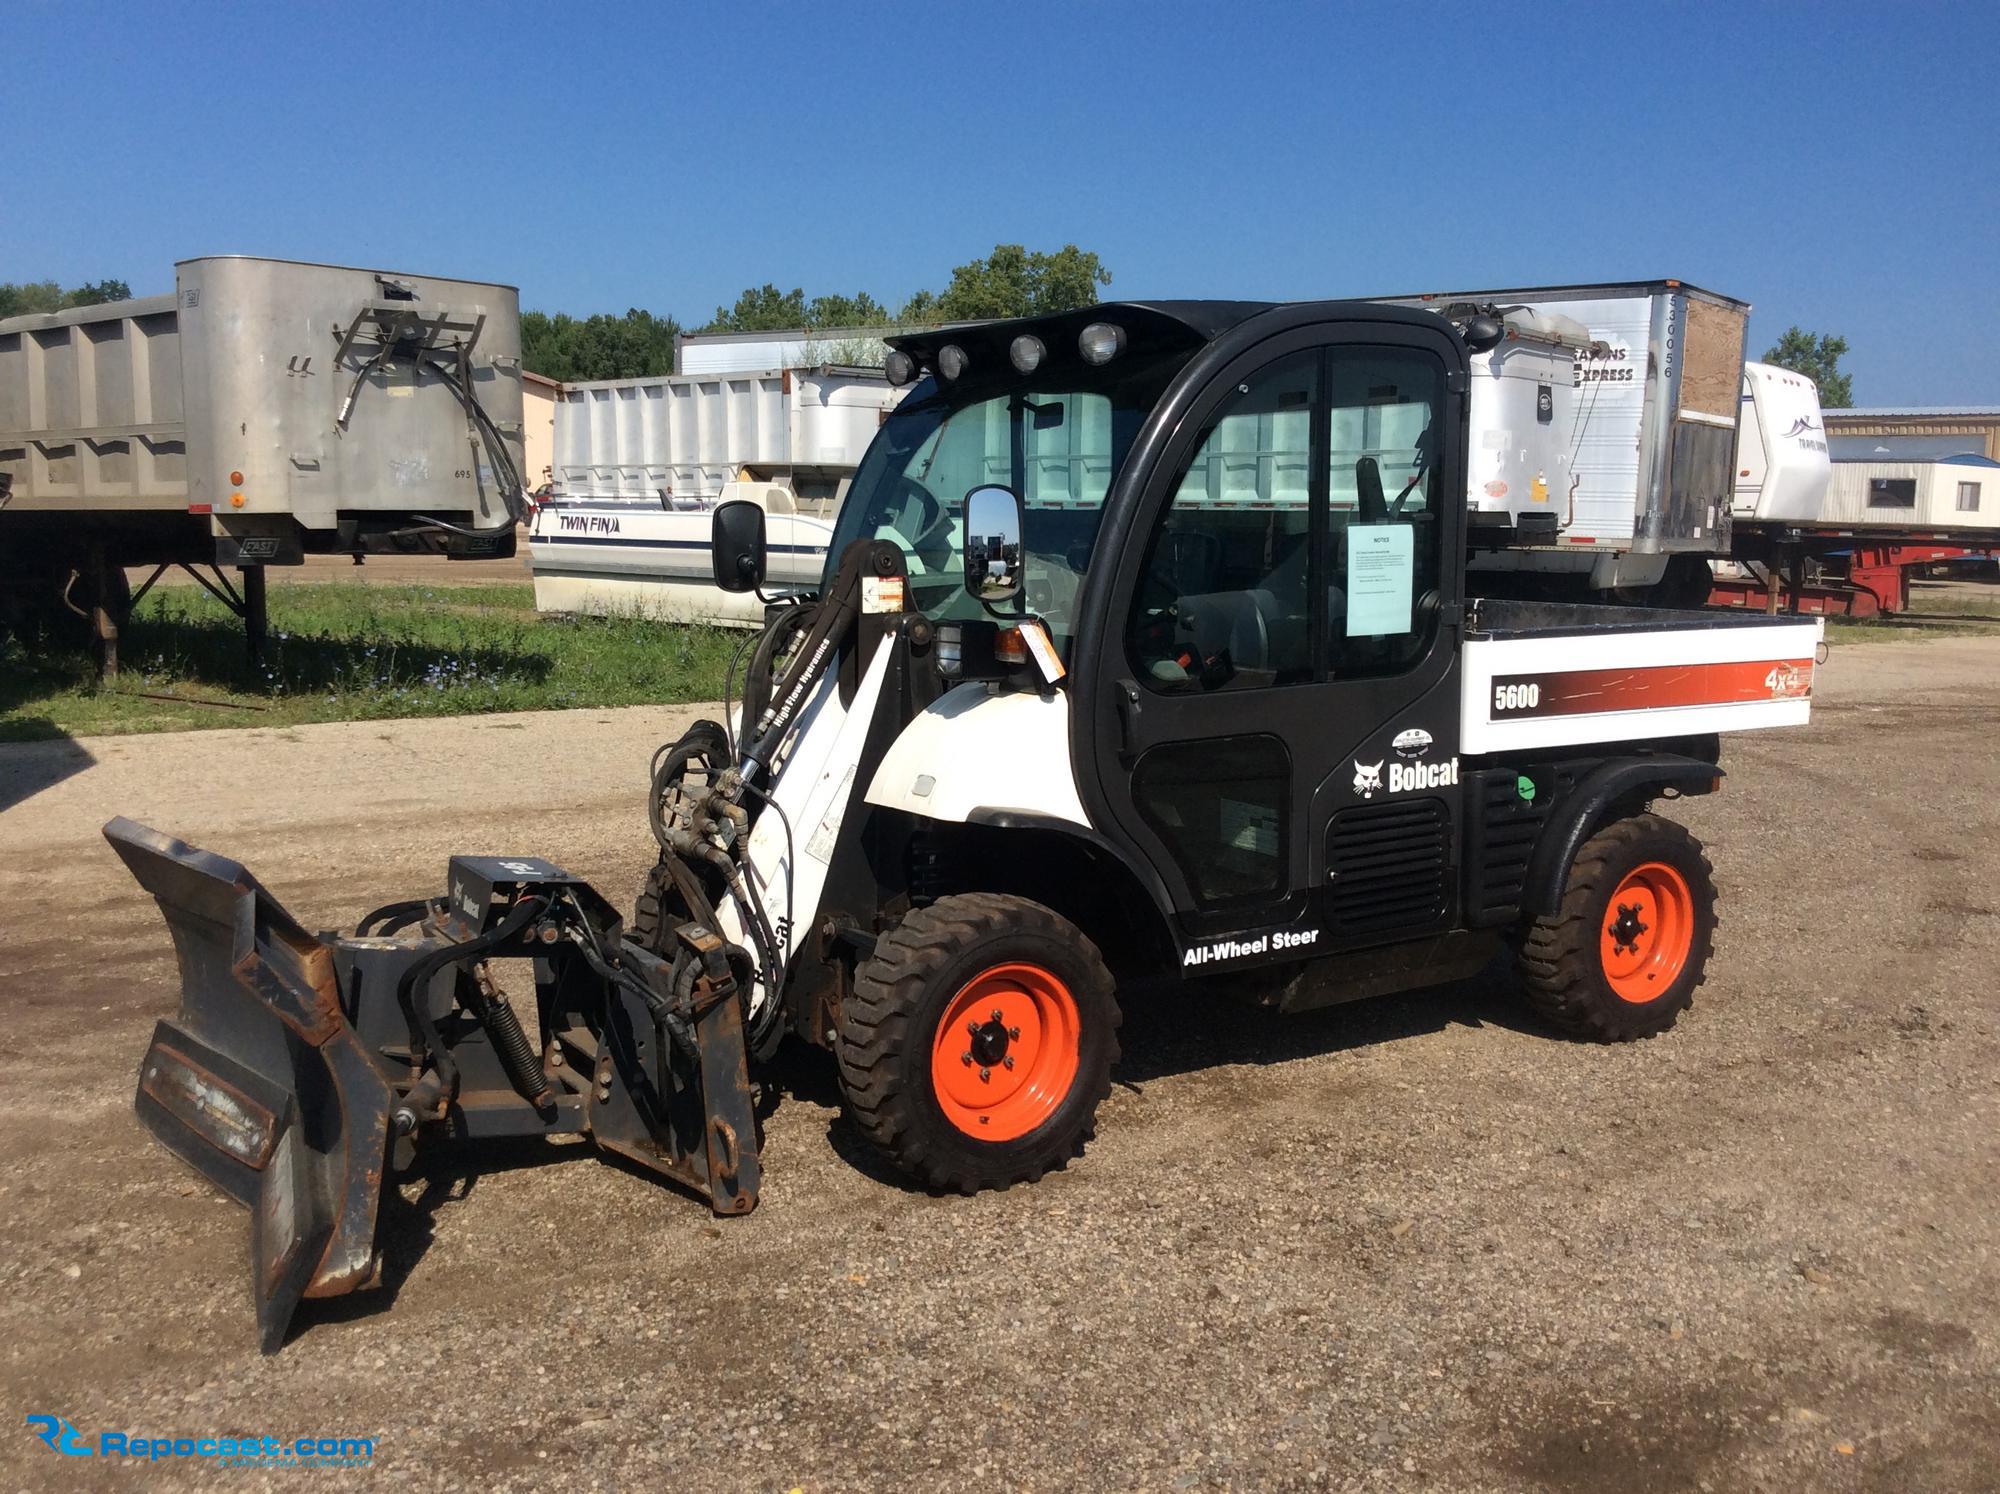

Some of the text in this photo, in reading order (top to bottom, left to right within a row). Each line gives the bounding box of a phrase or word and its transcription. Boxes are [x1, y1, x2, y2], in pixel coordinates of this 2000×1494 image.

[454, 470, 471, 479] 695
[560, 515, 611, 536] TWIN FIN
[773, 638, 831, 728] High Flow Hydraulics
[1495, 683, 1540, 710] 5600
[1389, 757, 1459, 793] Bobcat
[1183, 929, 1319, 966] All-Wheel Steer
